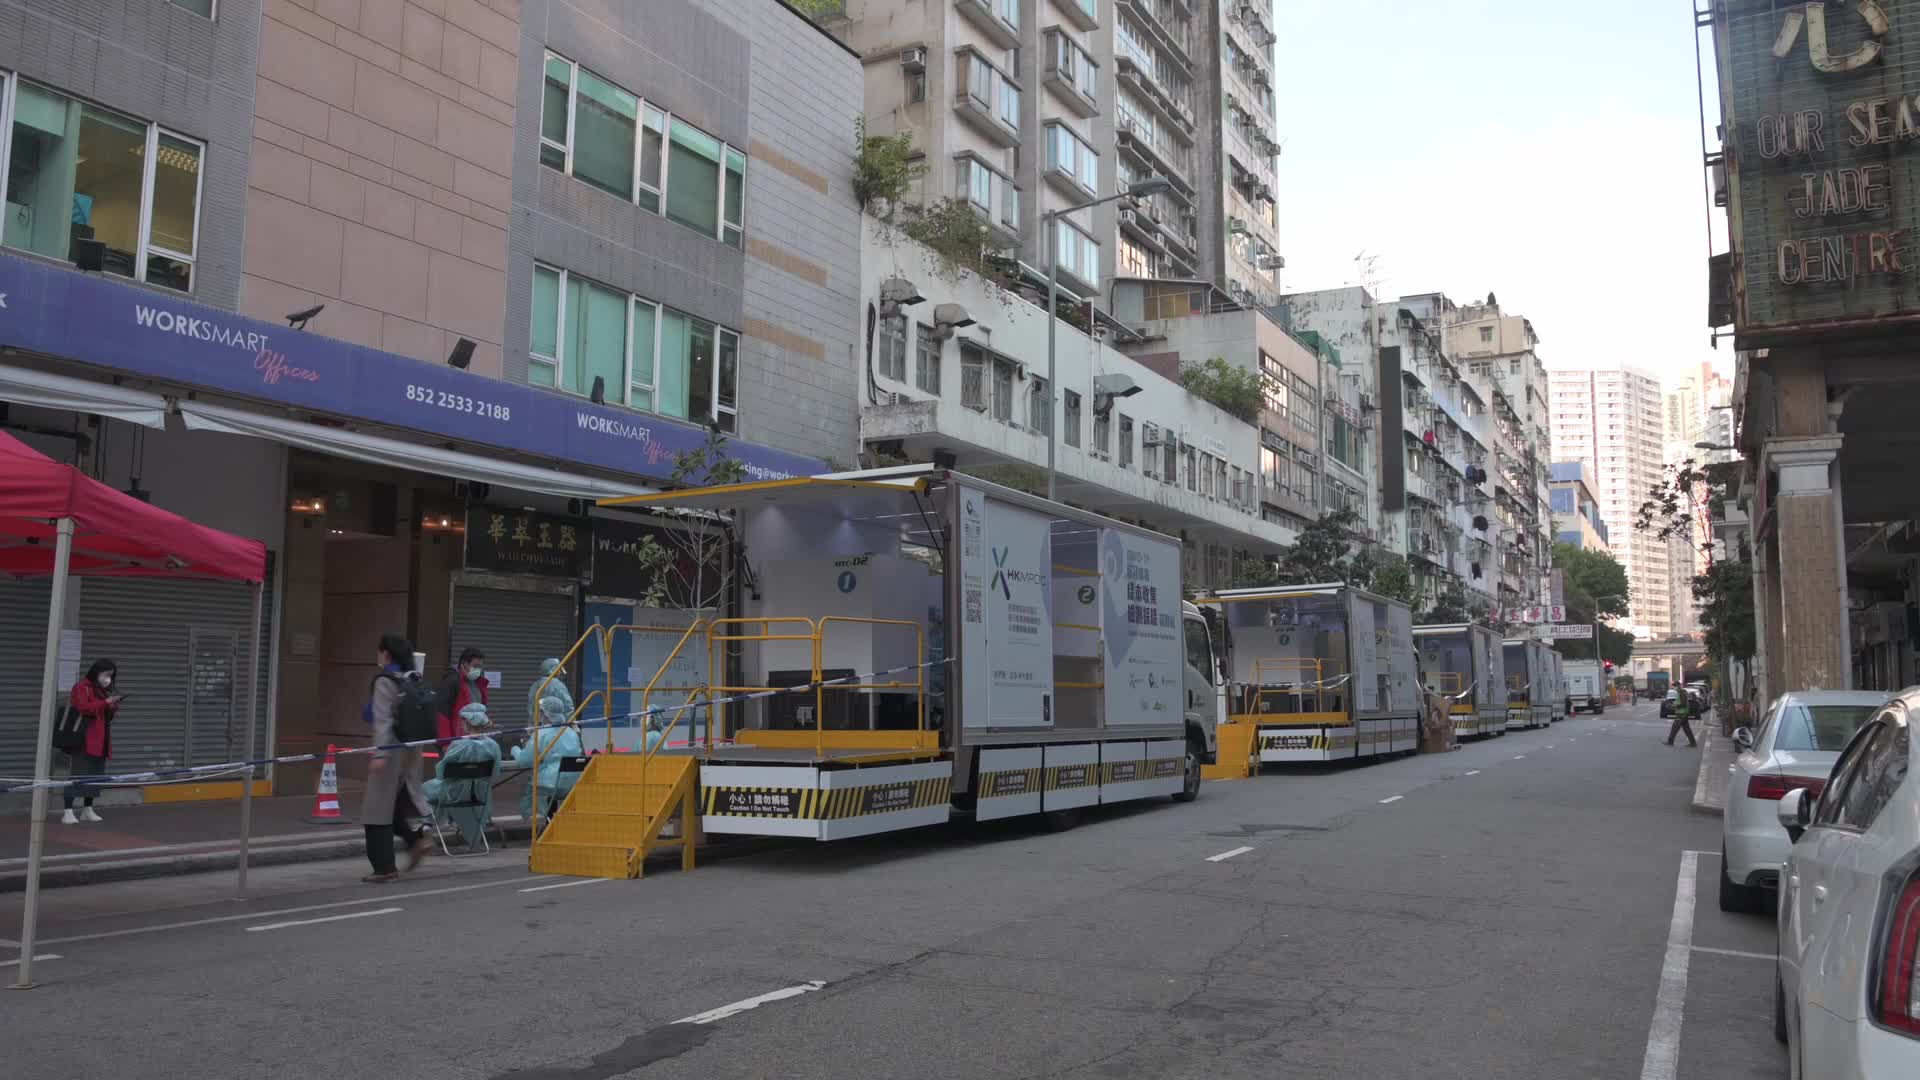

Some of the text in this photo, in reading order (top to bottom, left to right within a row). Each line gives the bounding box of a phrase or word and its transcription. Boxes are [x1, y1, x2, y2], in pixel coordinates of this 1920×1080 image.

[1845, 96, 1920, 148] SEA
[1794, 165, 1890, 219] JADE
[135, 304, 269, 353] WORKSMART
[254, 349, 320, 385] Offices
[406, 384, 511, 422] 852 2533 2188
[576, 412, 651, 443] WORKSMART
